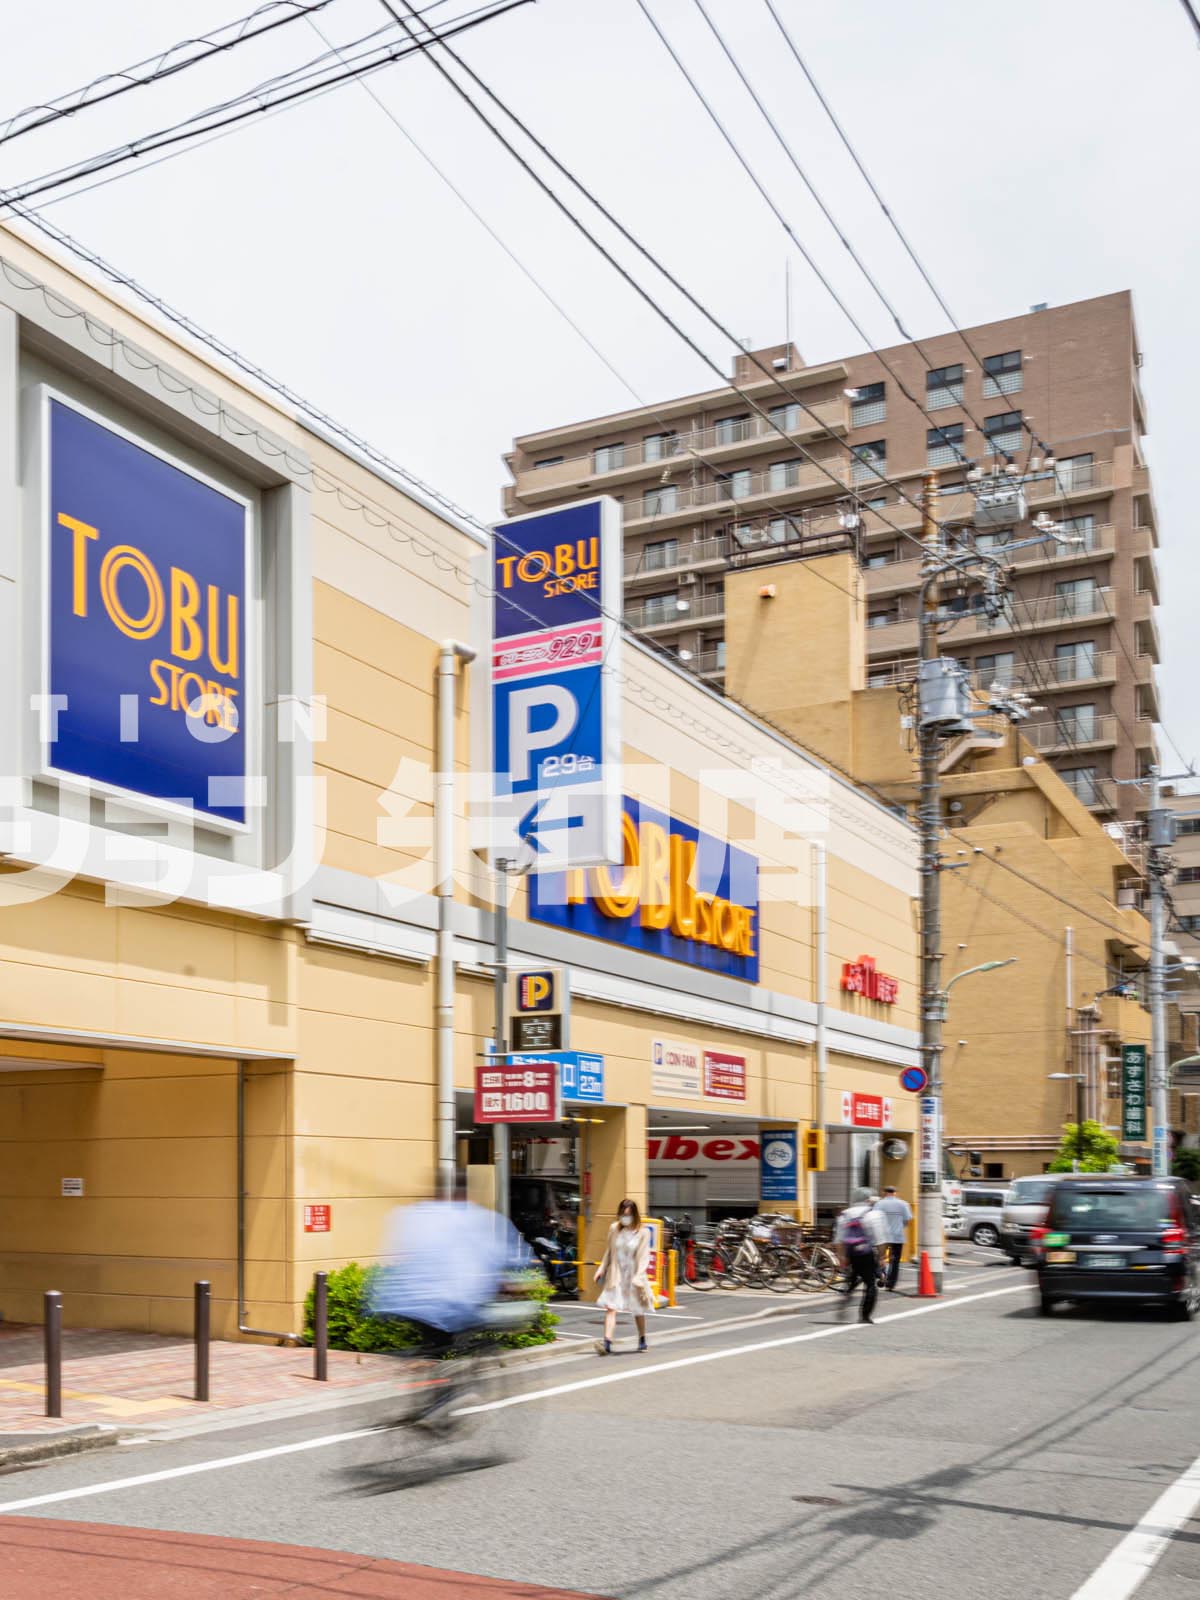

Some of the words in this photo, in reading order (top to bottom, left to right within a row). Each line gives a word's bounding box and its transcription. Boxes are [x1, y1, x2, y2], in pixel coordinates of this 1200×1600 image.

[496, 537, 600, 589] TOBU
[543, 571, 600, 599] STORE
[57, 512, 239, 679] TOBU
[547, 632, 594, 661] 929
[149, 658, 240, 734] STORE
[508, 684, 579, 782] P
[527, 976, 550, 1008] P
